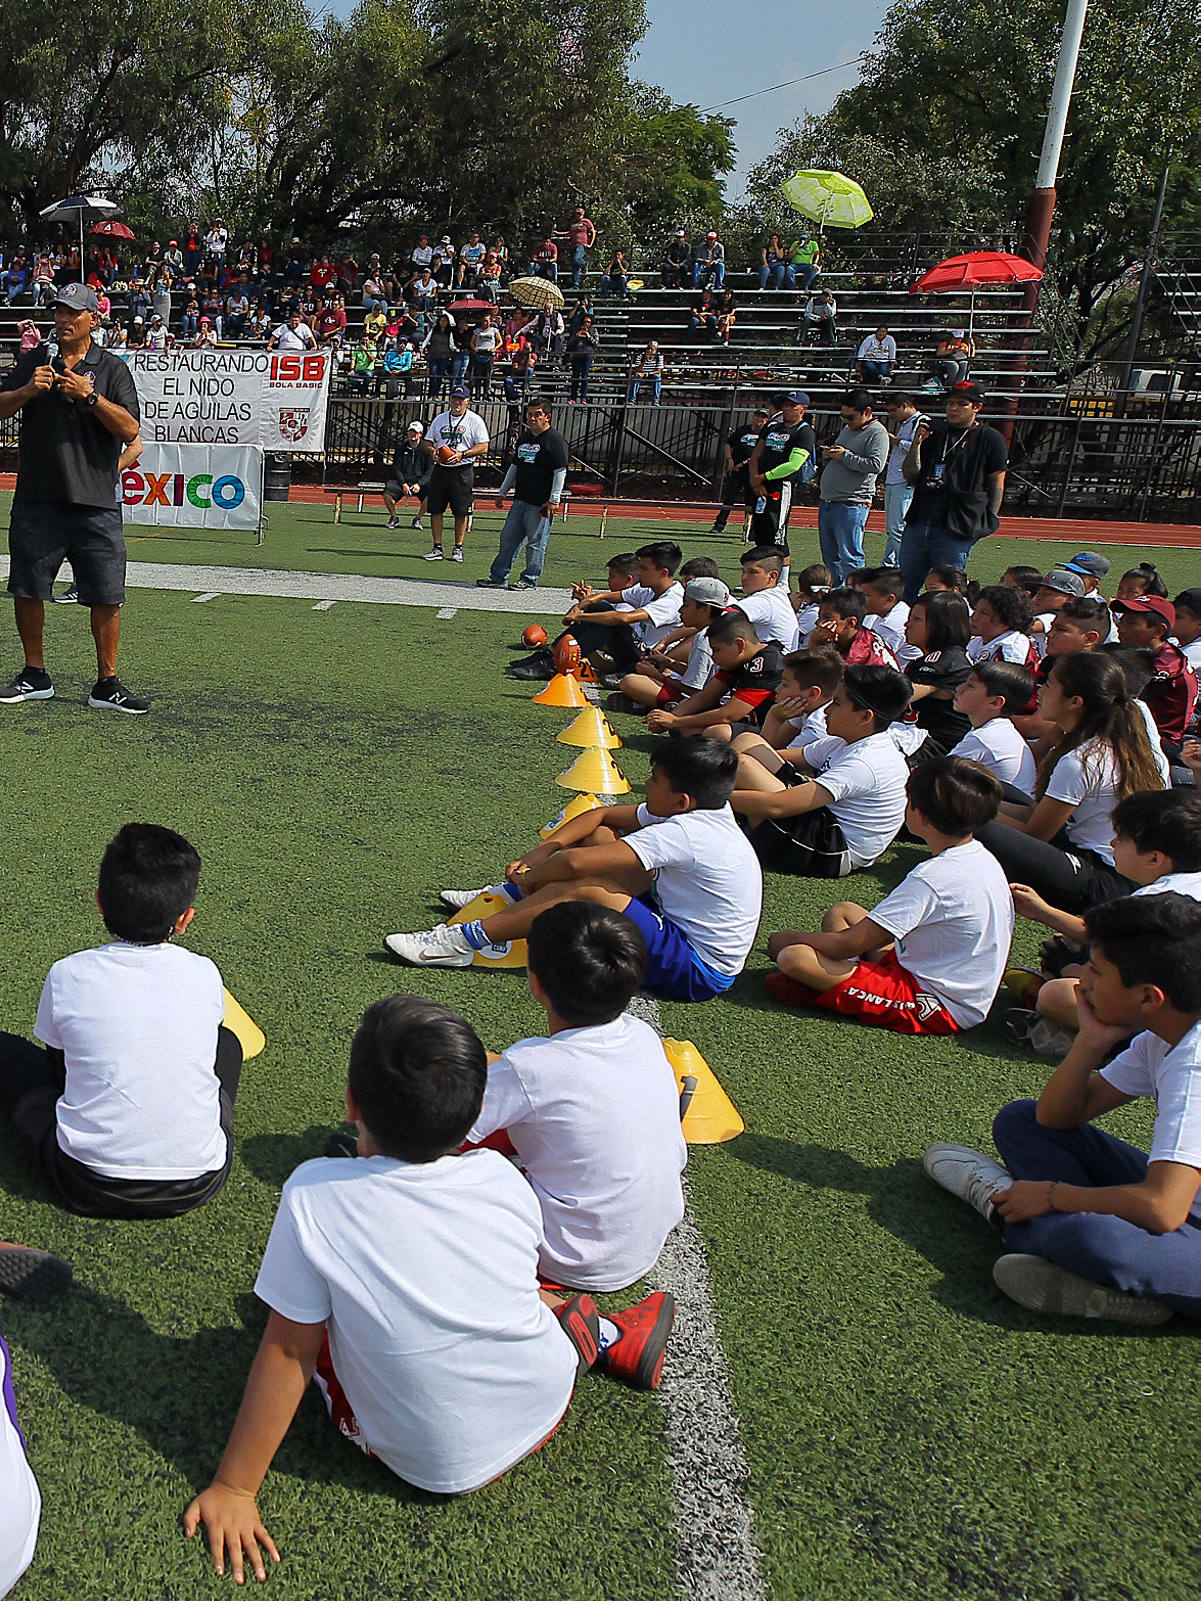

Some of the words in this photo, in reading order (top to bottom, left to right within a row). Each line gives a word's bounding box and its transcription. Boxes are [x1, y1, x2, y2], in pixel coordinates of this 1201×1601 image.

[134, 354, 269, 373] RESTAURANDO
[269, 355, 325, 381] ISB
[163, 377, 185, 396] EL
[189, 378, 235, 397] NIDO
[144, 402, 170, 420] DE
[171, 402, 252, 421] AGUILAS
[154, 425, 239, 444] BLANCAS
